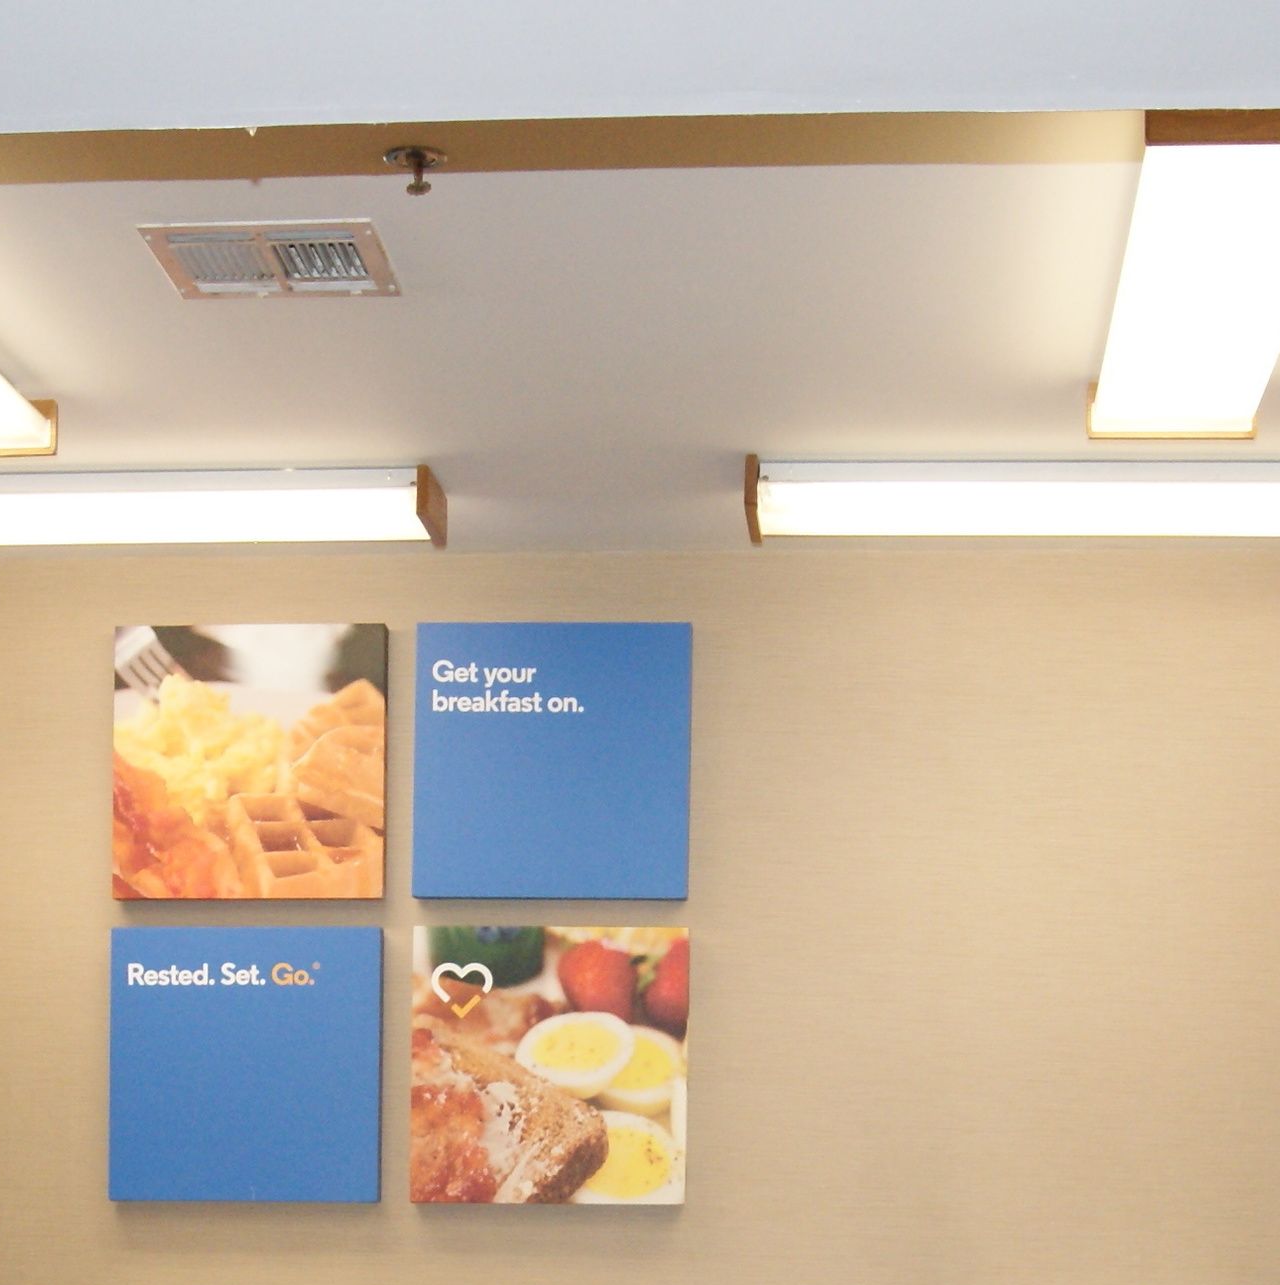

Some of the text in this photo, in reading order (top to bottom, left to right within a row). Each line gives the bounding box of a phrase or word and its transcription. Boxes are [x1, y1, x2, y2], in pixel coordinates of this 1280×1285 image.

[431, 659, 537, 687] Get your
[431, 689, 585, 713] breakfast on.
[127, 962, 216, 986] Rested.
[220, 962, 266, 986] Set.
